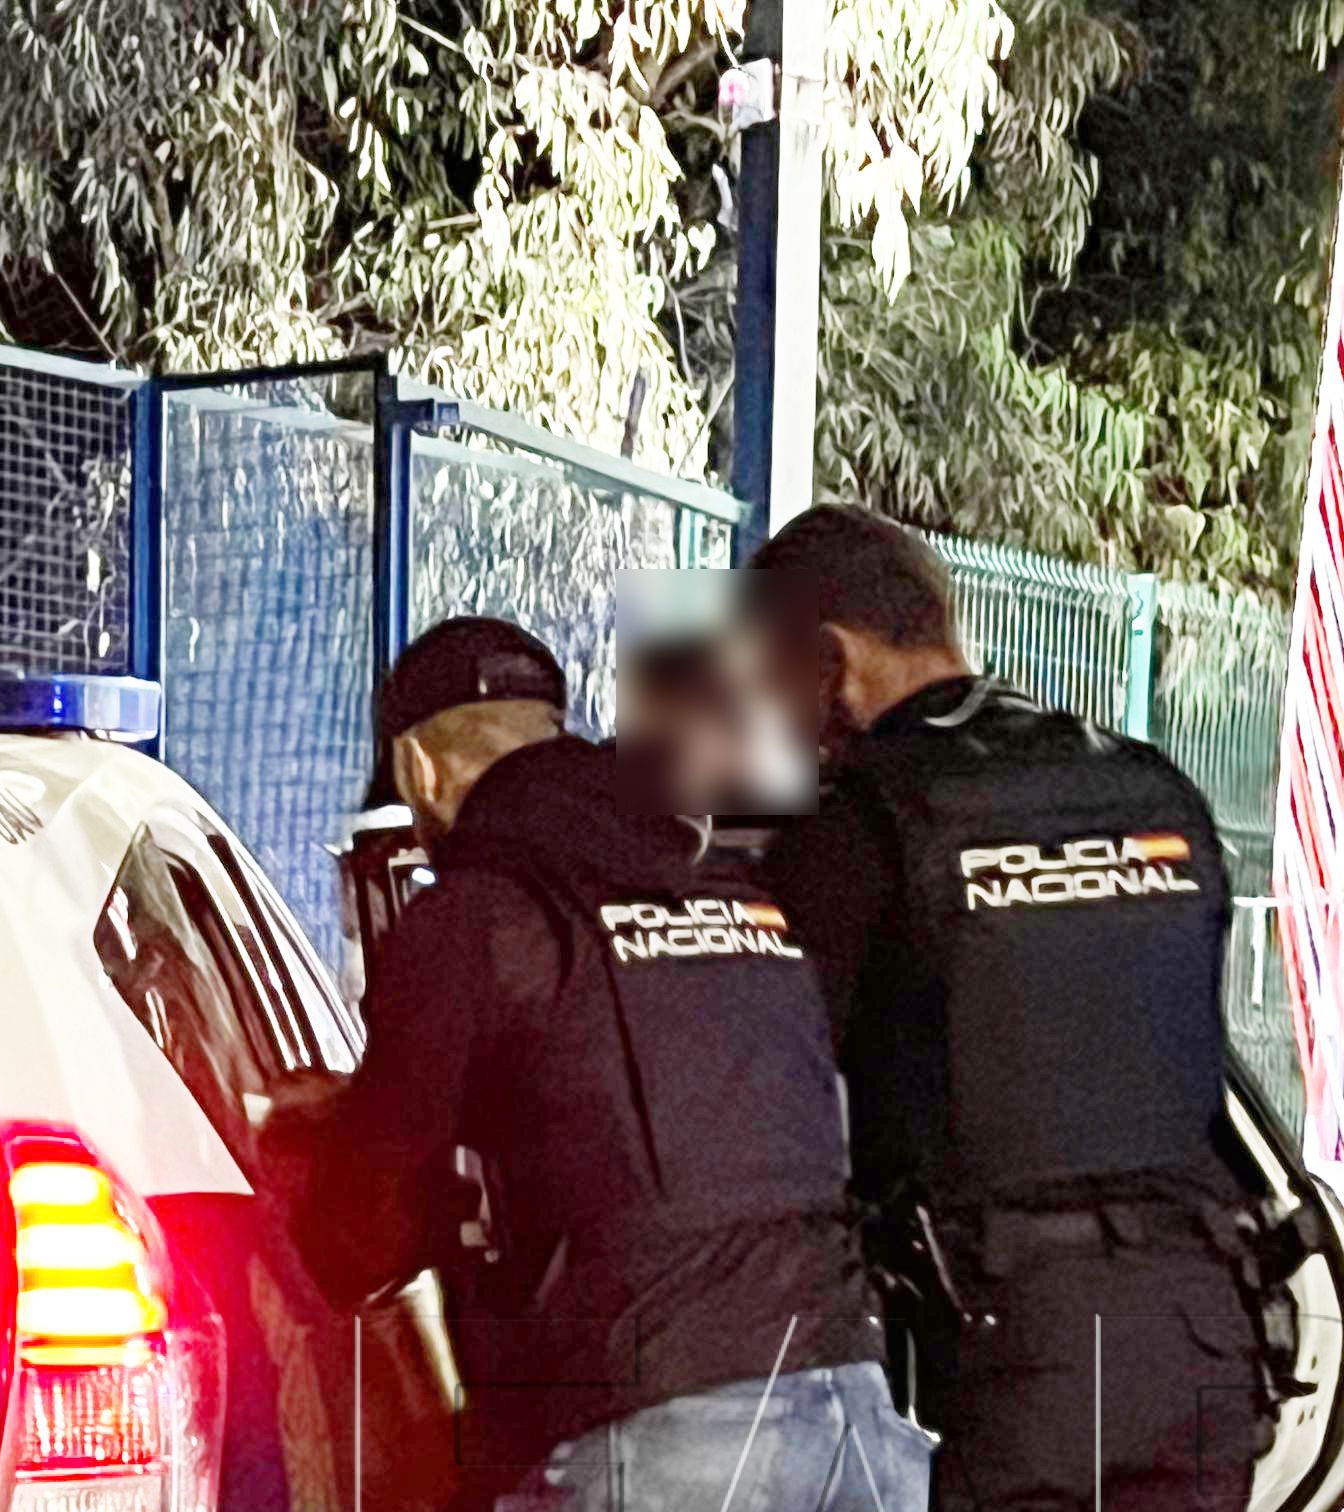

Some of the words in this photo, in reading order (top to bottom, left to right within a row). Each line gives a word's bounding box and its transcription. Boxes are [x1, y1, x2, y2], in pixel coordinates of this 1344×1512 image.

[960, 837, 1148, 877] POLICIA
[967, 864, 1200, 911] NACIONAL
[600, 899, 757, 931] POLICIA
[612, 927, 803, 963] NACIONAL
